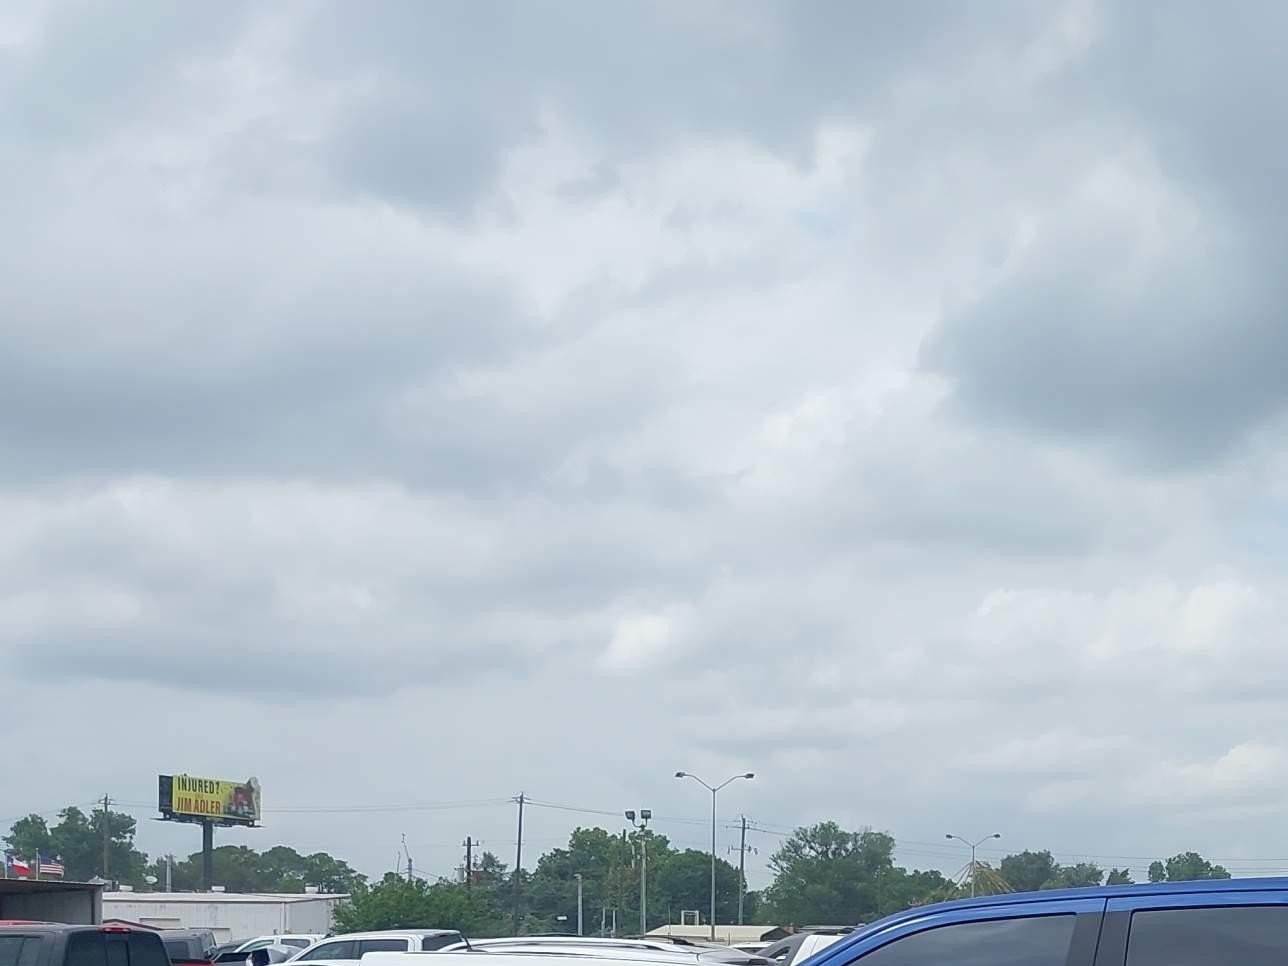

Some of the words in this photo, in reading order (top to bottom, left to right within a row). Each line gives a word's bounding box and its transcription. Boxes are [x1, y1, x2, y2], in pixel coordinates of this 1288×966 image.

[177, 776, 220, 795] INJURED?
[176, 796, 192, 812] JIM
[194, 799, 221, 815] ADLER
